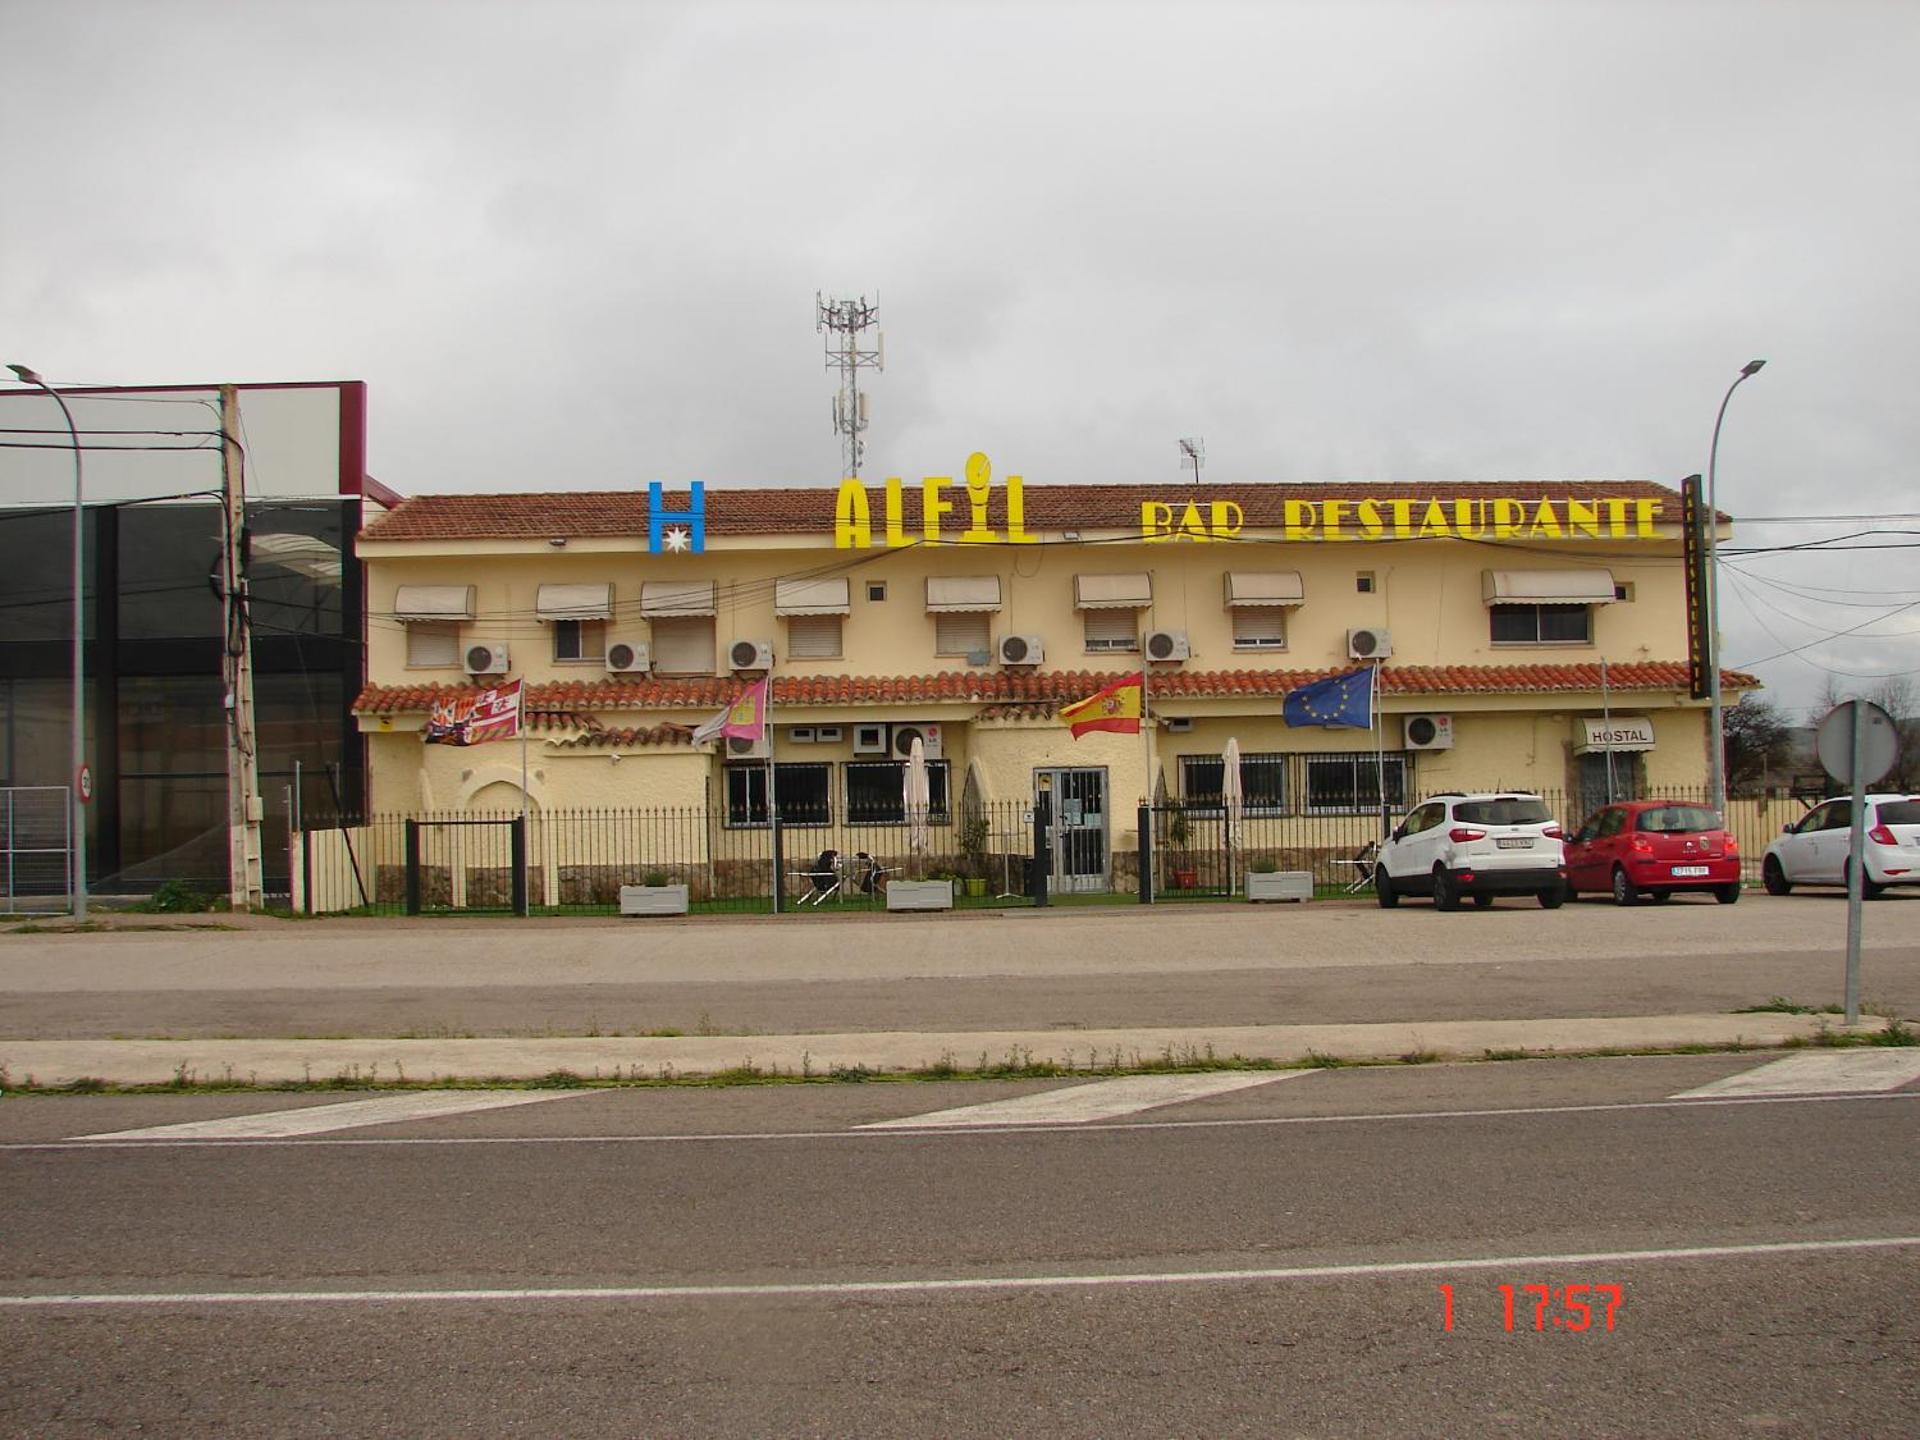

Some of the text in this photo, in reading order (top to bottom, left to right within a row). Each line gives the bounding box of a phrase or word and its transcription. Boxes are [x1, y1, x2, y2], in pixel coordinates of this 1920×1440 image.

[648, 481, 705, 553] H
[1141, 495, 1665, 544] BAR RESTAURANTE
[1592, 730, 1648, 742] HOSTAL
